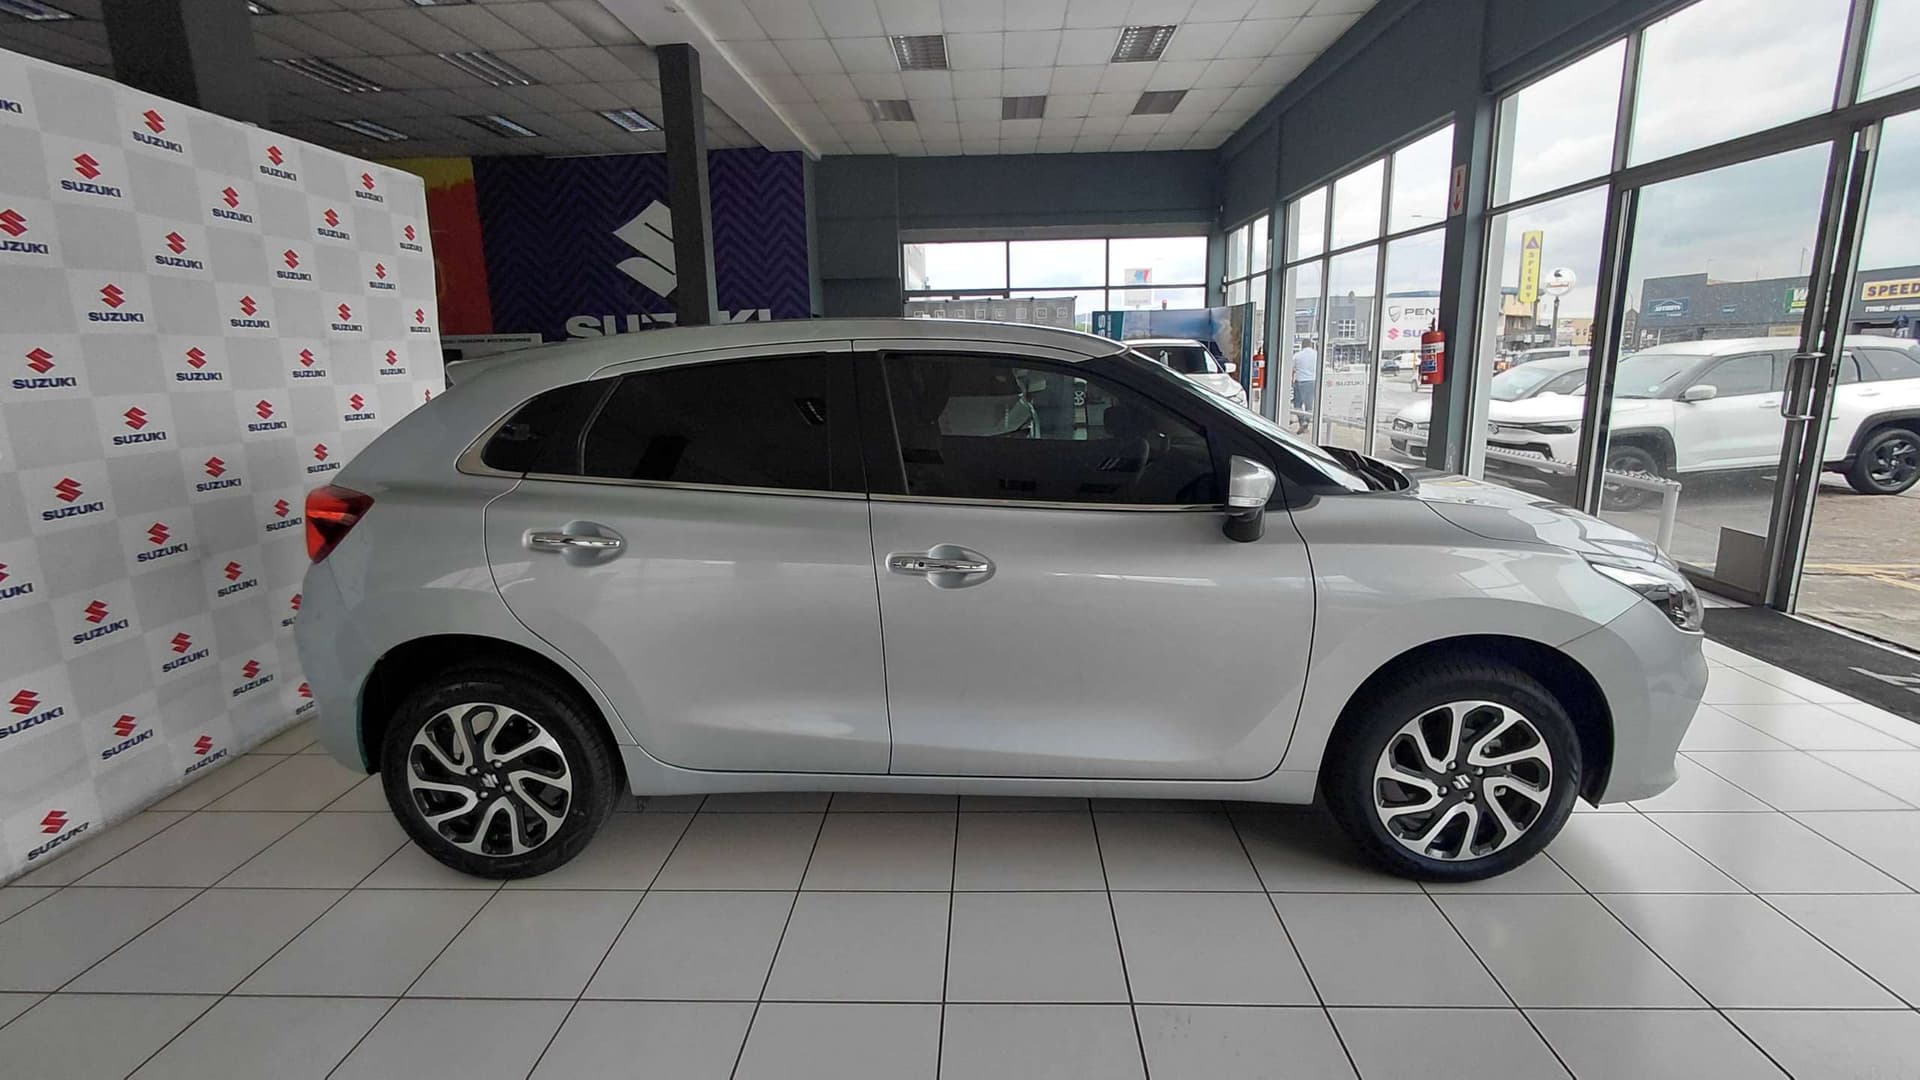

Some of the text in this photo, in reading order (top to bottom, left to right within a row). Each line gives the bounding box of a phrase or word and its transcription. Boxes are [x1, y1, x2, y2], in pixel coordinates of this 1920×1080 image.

[133, 131, 182, 153] SUZUKI
[260, 165, 296, 181] SUZUKI
[61, 180, 121, 197] SUZUKI
[355, 191, 383, 202] SUZUKI
[212, 208, 252, 223] SUZUKI
[318, 228, 349, 240] SUZUKI
[400, 243, 422, 252] SUZUKI
[155, 255, 203, 269] SUZUKI
[277, 271, 311, 280] SUZUKI
[1867, 282, 1920, 297] SPEED
[88, 312, 144, 322] SUZUKI
[230, 319, 270, 328] SUZUKI
[12, 373, 77, 389] SUZUKI
[176, 373, 222, 381] SUZUKI
[293, 370, 326, 378] SUZUKI
[345, 413, 375, 421] SUZUKI
[248, 421, 287, 431] SUZUKI
[113, 432, 166, 445] SUZUKI
[307, 463, 339, 473] SUZUKI
[196, 478, 241, 492] SUZUKI
[42, 502, 104, 520] SUZUKI
[266, 518, 301, 531] SUZUKI
[137, 543, 188, 562] SUZUKI
[218, 579, 257, 597] SUZUKI
[73, 619, 128, 644] SUZUKI
[163, 649, 208, 672] SUZUKI
[233, 675, 273, 696] SUZUKI
[0, 707, 64, 739] SUZUKI
[102, 729, 153, 760] SUZUKI
[185, 749, 227, 775] SUZUKI
[28, 823, 89, 860] SUZUKI
